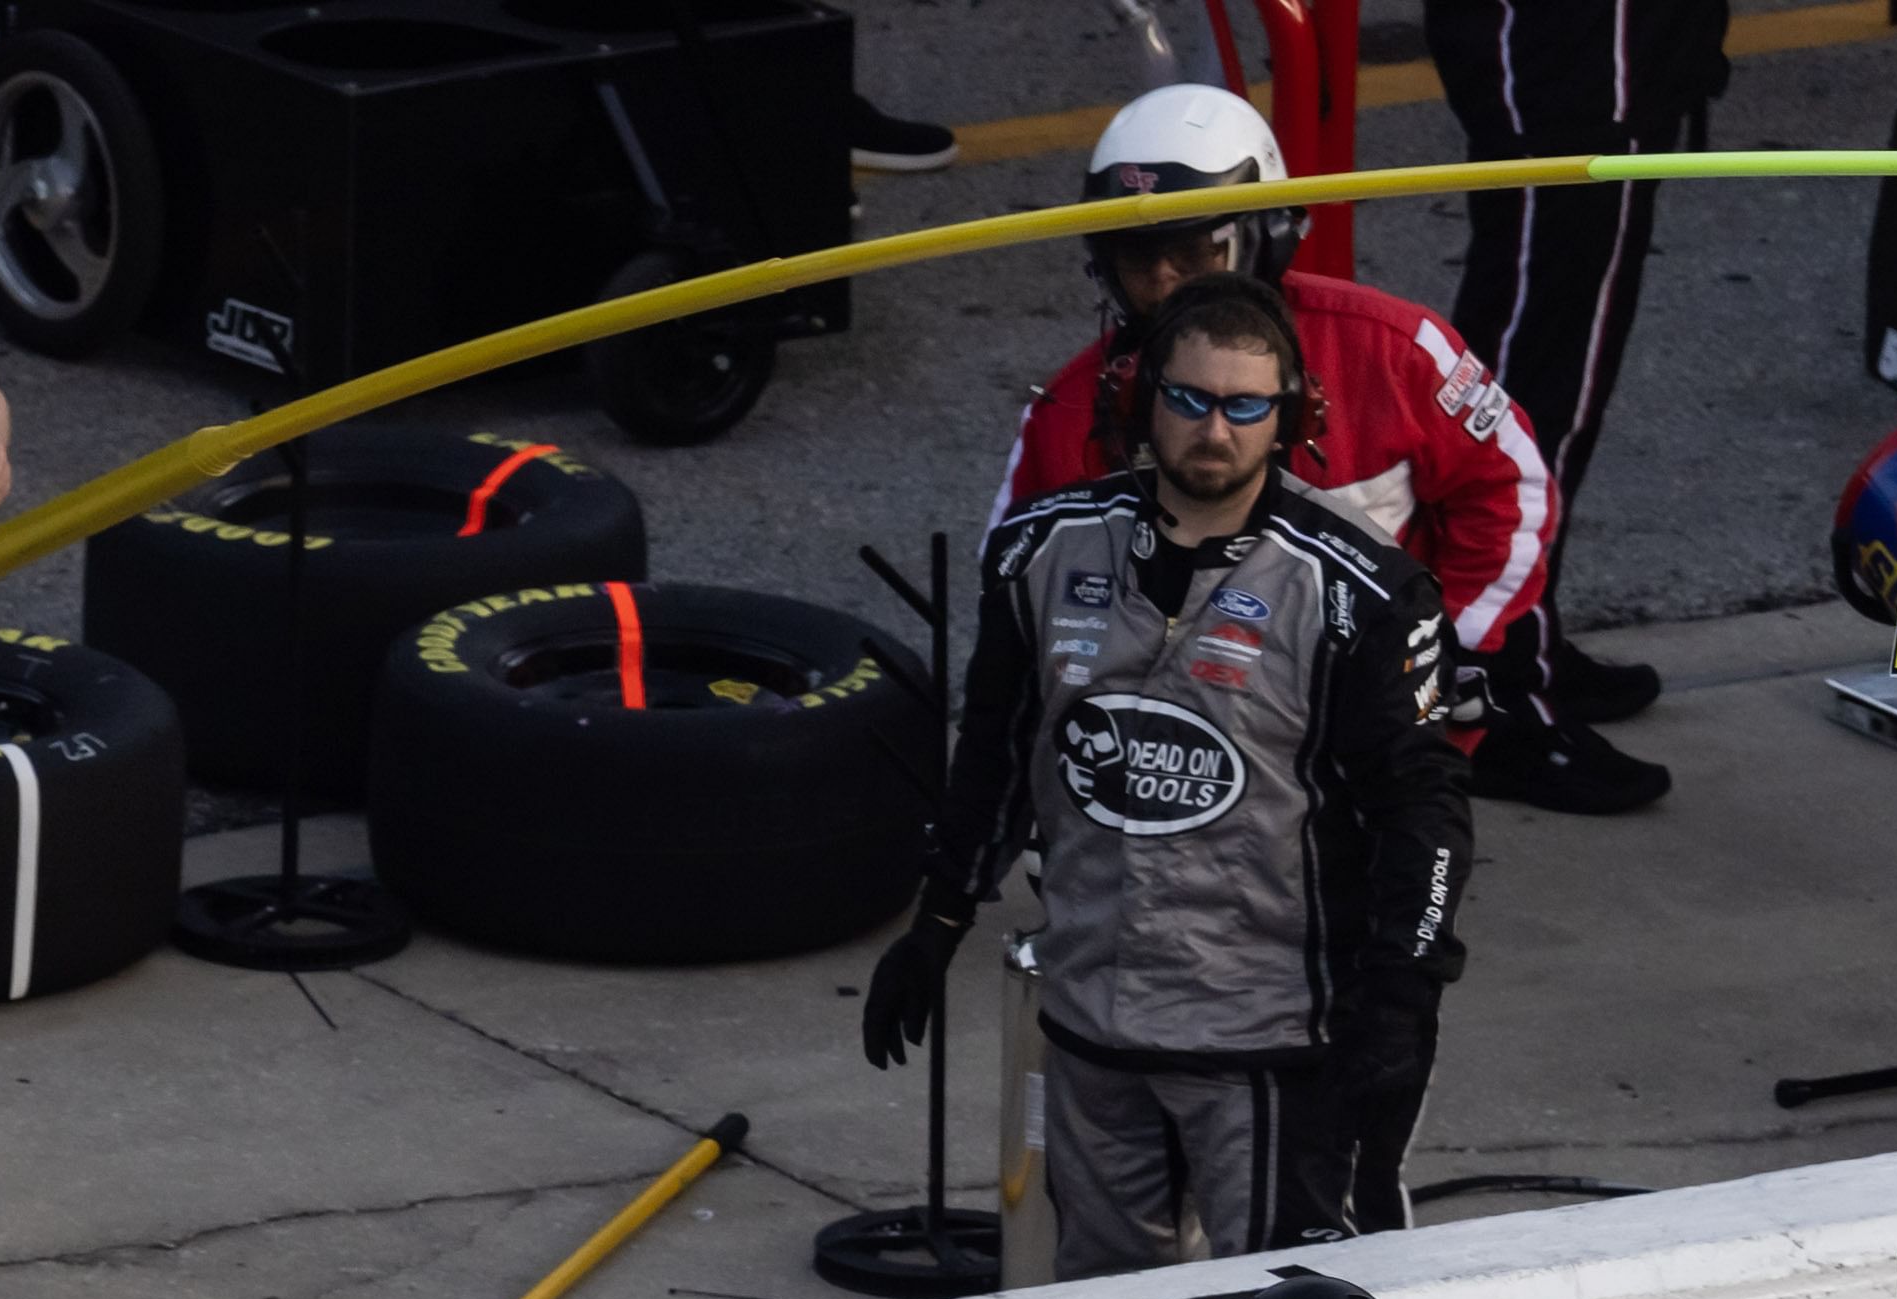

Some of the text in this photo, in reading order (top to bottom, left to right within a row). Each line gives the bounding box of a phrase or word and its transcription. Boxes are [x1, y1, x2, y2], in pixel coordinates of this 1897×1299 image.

[1125, 740, 1224, 779] DEAD ON
[1124, 771, 1216, 808] TOOLS
